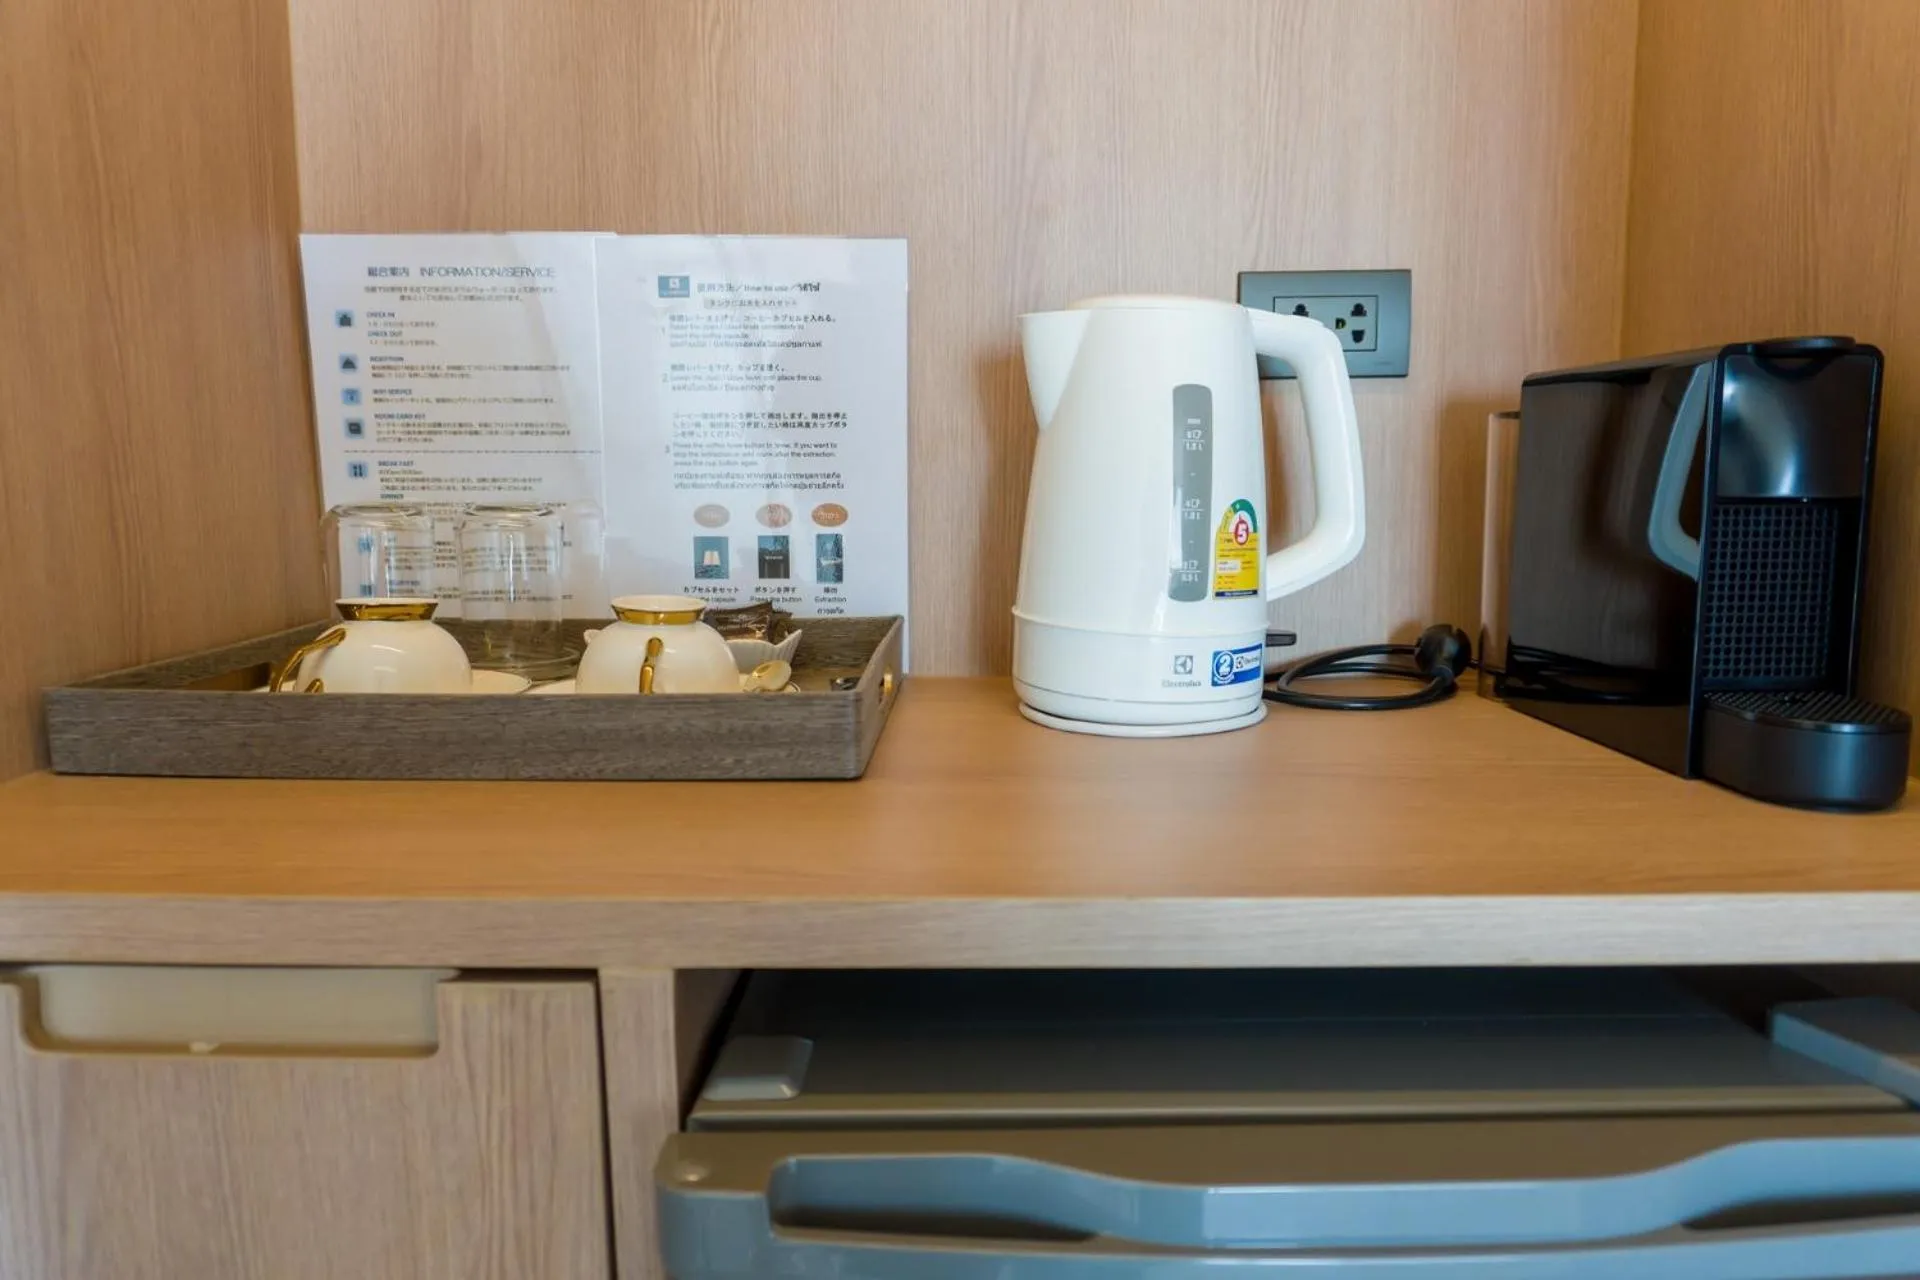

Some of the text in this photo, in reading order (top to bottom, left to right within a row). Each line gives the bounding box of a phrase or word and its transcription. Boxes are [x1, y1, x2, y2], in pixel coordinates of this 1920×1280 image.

[419, 266, 556, 278] INFORMATION/SERVICE
[1236, 521, 1248, 544] 5
[1219, 654, 1231, 676] 2
